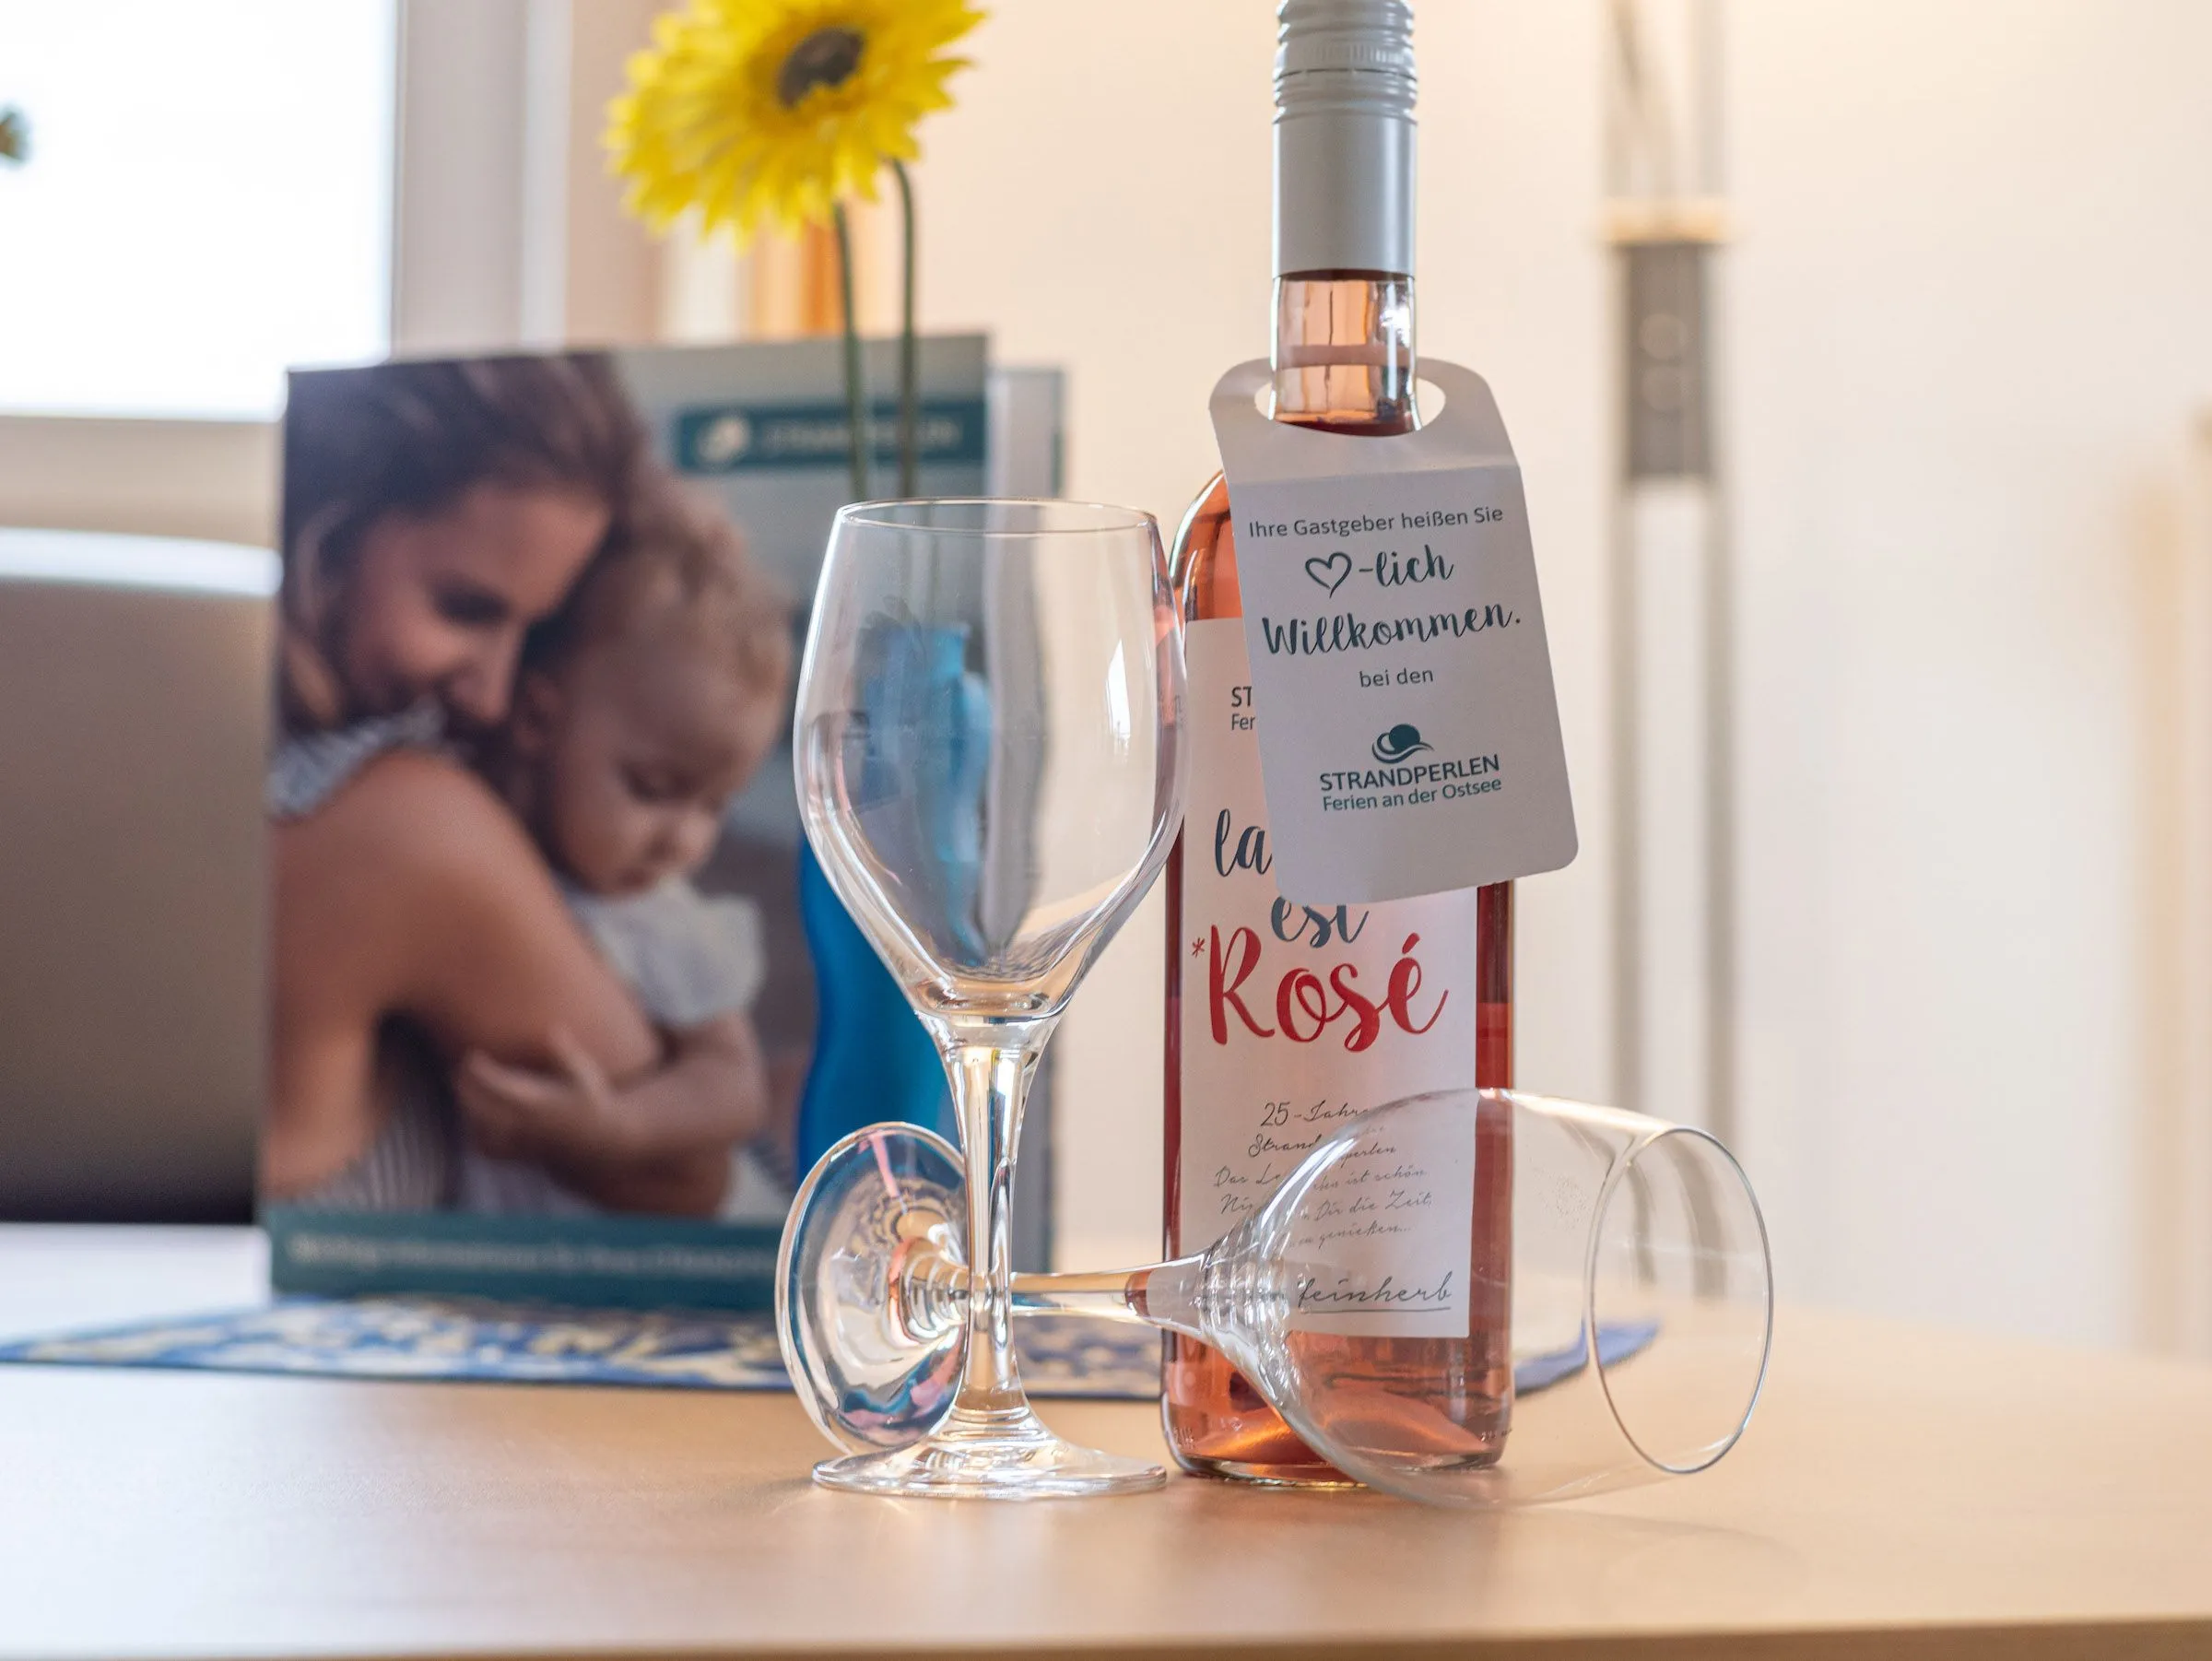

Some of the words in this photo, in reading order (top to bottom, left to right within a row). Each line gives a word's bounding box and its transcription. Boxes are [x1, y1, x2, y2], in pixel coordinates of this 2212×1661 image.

[1249, 520, 1288, 537] Ihre
[1293, 515, 1395, 538] Gastgeber
[1400, 509, 1468, 530] heißen
[1474, 505, 1503, 524] Sie
[1261, 603, 1521, 655] Willkommen.
[1359, 668, 1390, 689] bei
[1396, 666, 1434, 686] den
[1231, 713, 1256, 730] Fer
[1320, 754, 1500, 792] STRANDPERLEN
[1323, 794, 1378, 811] Ferien
[1382, 794, 1405, 807] an
[1408, 788, 1438, 806] der
[1441, 777, 1502, 800] Ostsee
[1214, 808, 1273, 877] la
